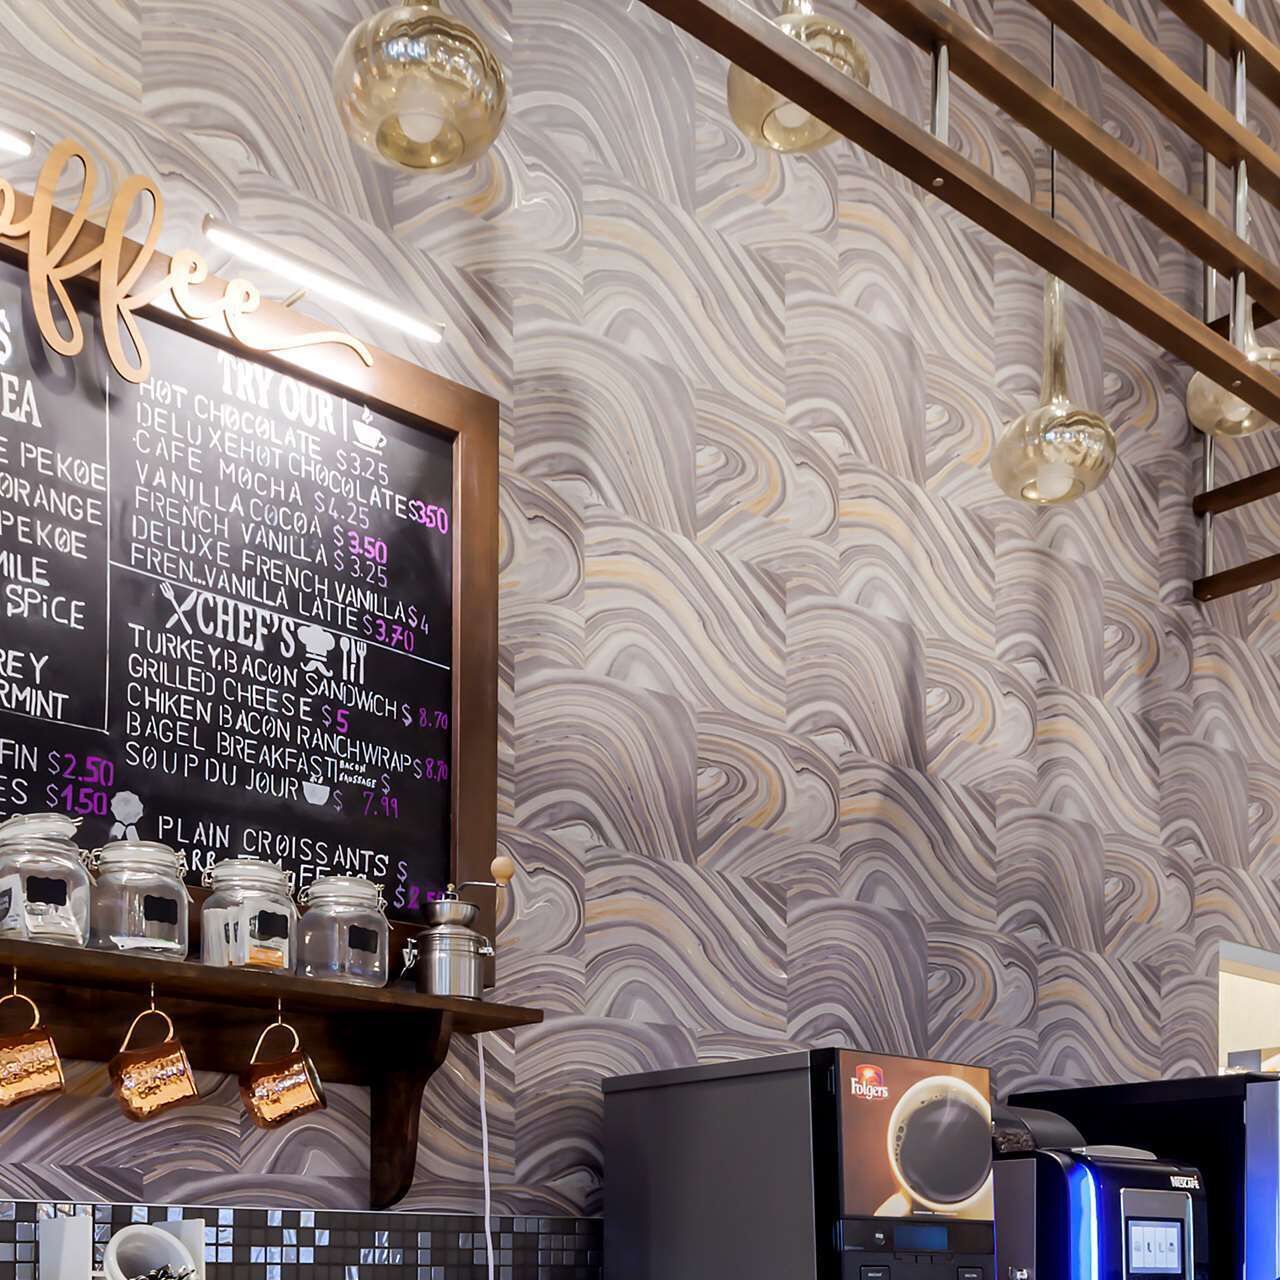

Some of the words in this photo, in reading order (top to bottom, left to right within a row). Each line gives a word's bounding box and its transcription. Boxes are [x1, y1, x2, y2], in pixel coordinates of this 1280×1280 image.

[217, 350, 276, 409] TRY
[279, 375, 337, 436] OUR
[140, 375, 188, 410] HOT
[194, 394, 323, 462] CHOCOLATE
[336, 448, 389, 486] $3.25
[20, 441, 107, 491] PEKOE
[136, 429, 202, 474] CAFE
[220, 458, 303, 507] MOCHA
[313, 491, 370, 530] $4.25
[287, 451, 409, 520] CHOCOLATE
[135, 459, 244, 517] VANILLA
[250, 497, 323, 538] COCOA
[333, 524, 388, 564] $3.50
[135, 486, 229, 539] FRENCH
[241, 522, 328, 568] VANILLA
[132, 514, 230, 568] DELUXE
[242, 549, 328, 598] FRENCH
[334, 580, 406, 623] VANILLA
[196, 591, 296, 659] CHEF'S
[298, 592, 359, 631] LATTE
[127, 682, 213, 724] CHIKEN
[219, 704, 291, 743] BACON
[128, 652, 216, 696] GRILLED
[223, 677, 313, 722] CHEESE
[48, 750, 114, 787] $2.50
[125, 741, 199, 779] SOUP
[205, 759, 237, 786] DU
[245, 771, 299, 802] JOUR
[126, 711, 206, 751] BAGEL
[217, 731, 336, 779] BREAKFAST
[339, 760, 366, 773] BACON
[46, 783, 109, 818] $1.50
[159, 815, 230, 849] PLAIN
[242, 827, 389, 877] CROISSANTS
[851, 1077, 889, 1100] Folgers
